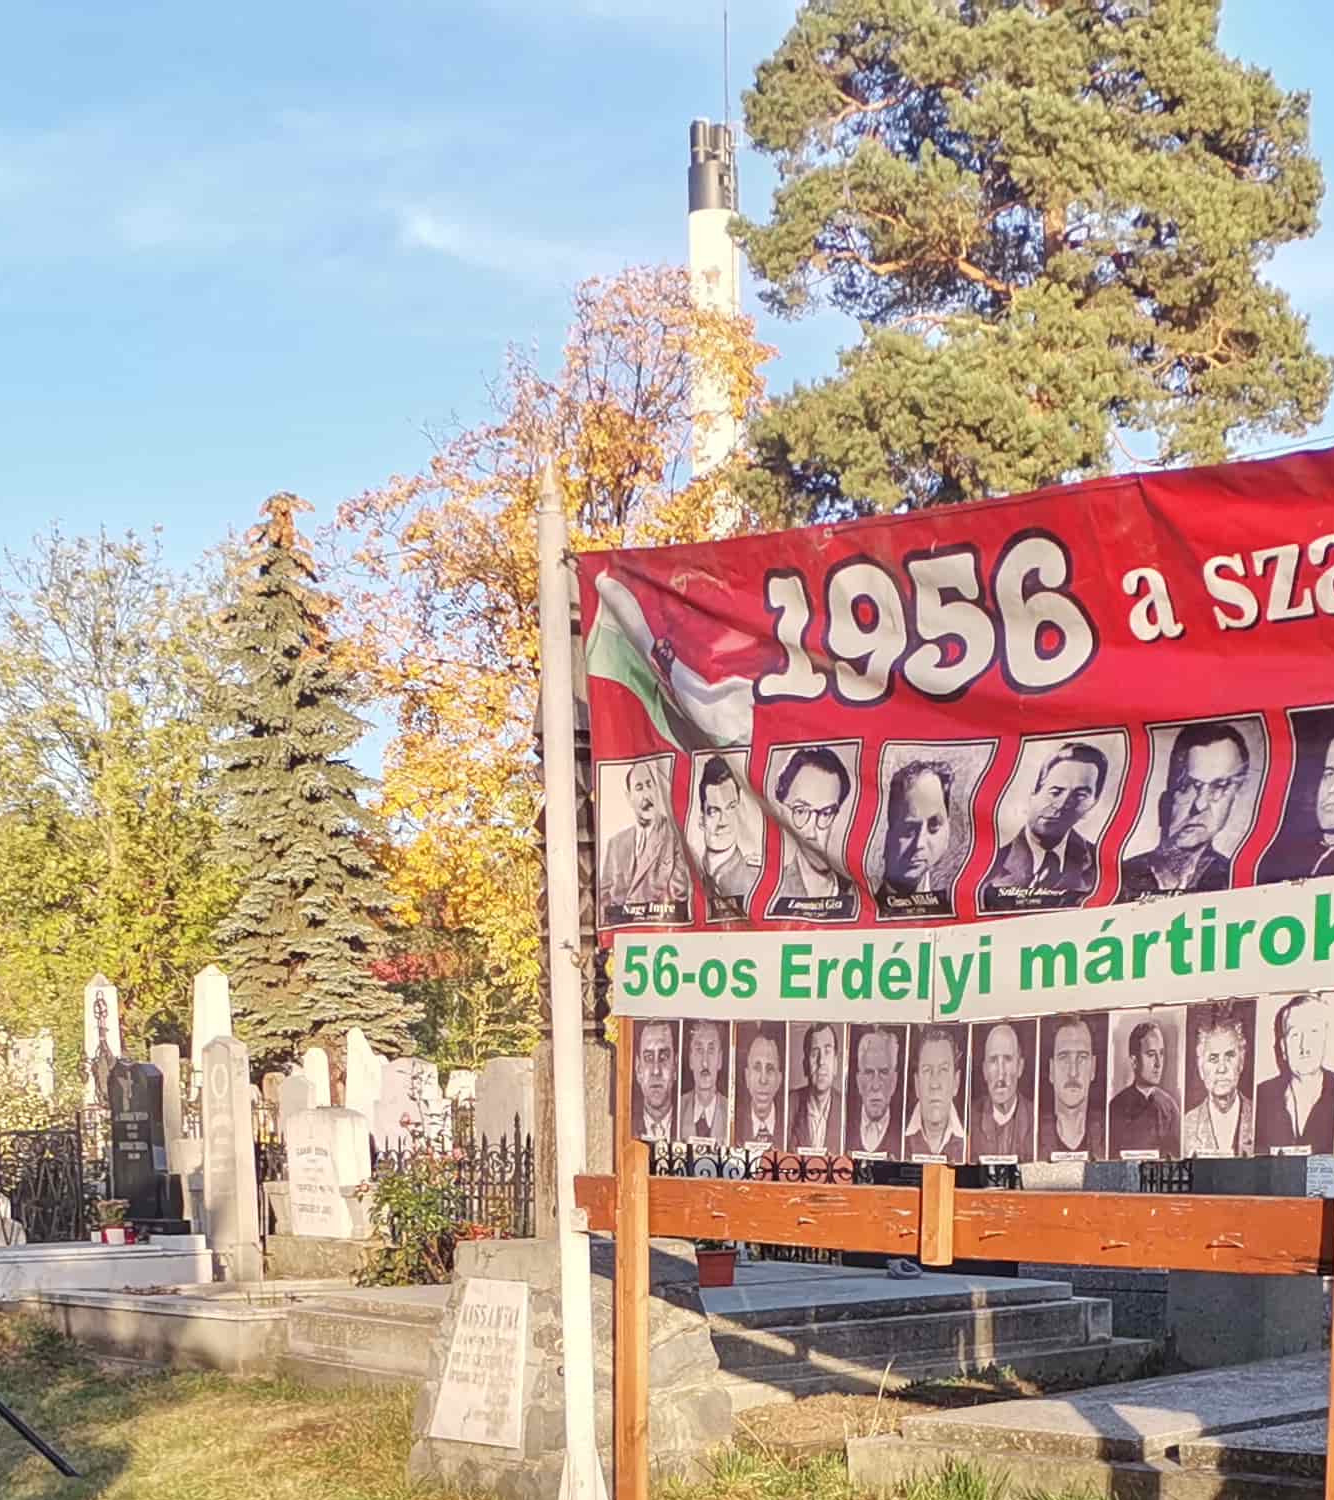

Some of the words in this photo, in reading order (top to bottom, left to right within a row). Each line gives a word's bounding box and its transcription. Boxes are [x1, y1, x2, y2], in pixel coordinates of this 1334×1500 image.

[753, 528, 1099, 706] 1956
[1122, 564, 1184, 642] a
[621, 943, 759, 999] 56-os
[780, 934, 993, 1016] Erdélyi
